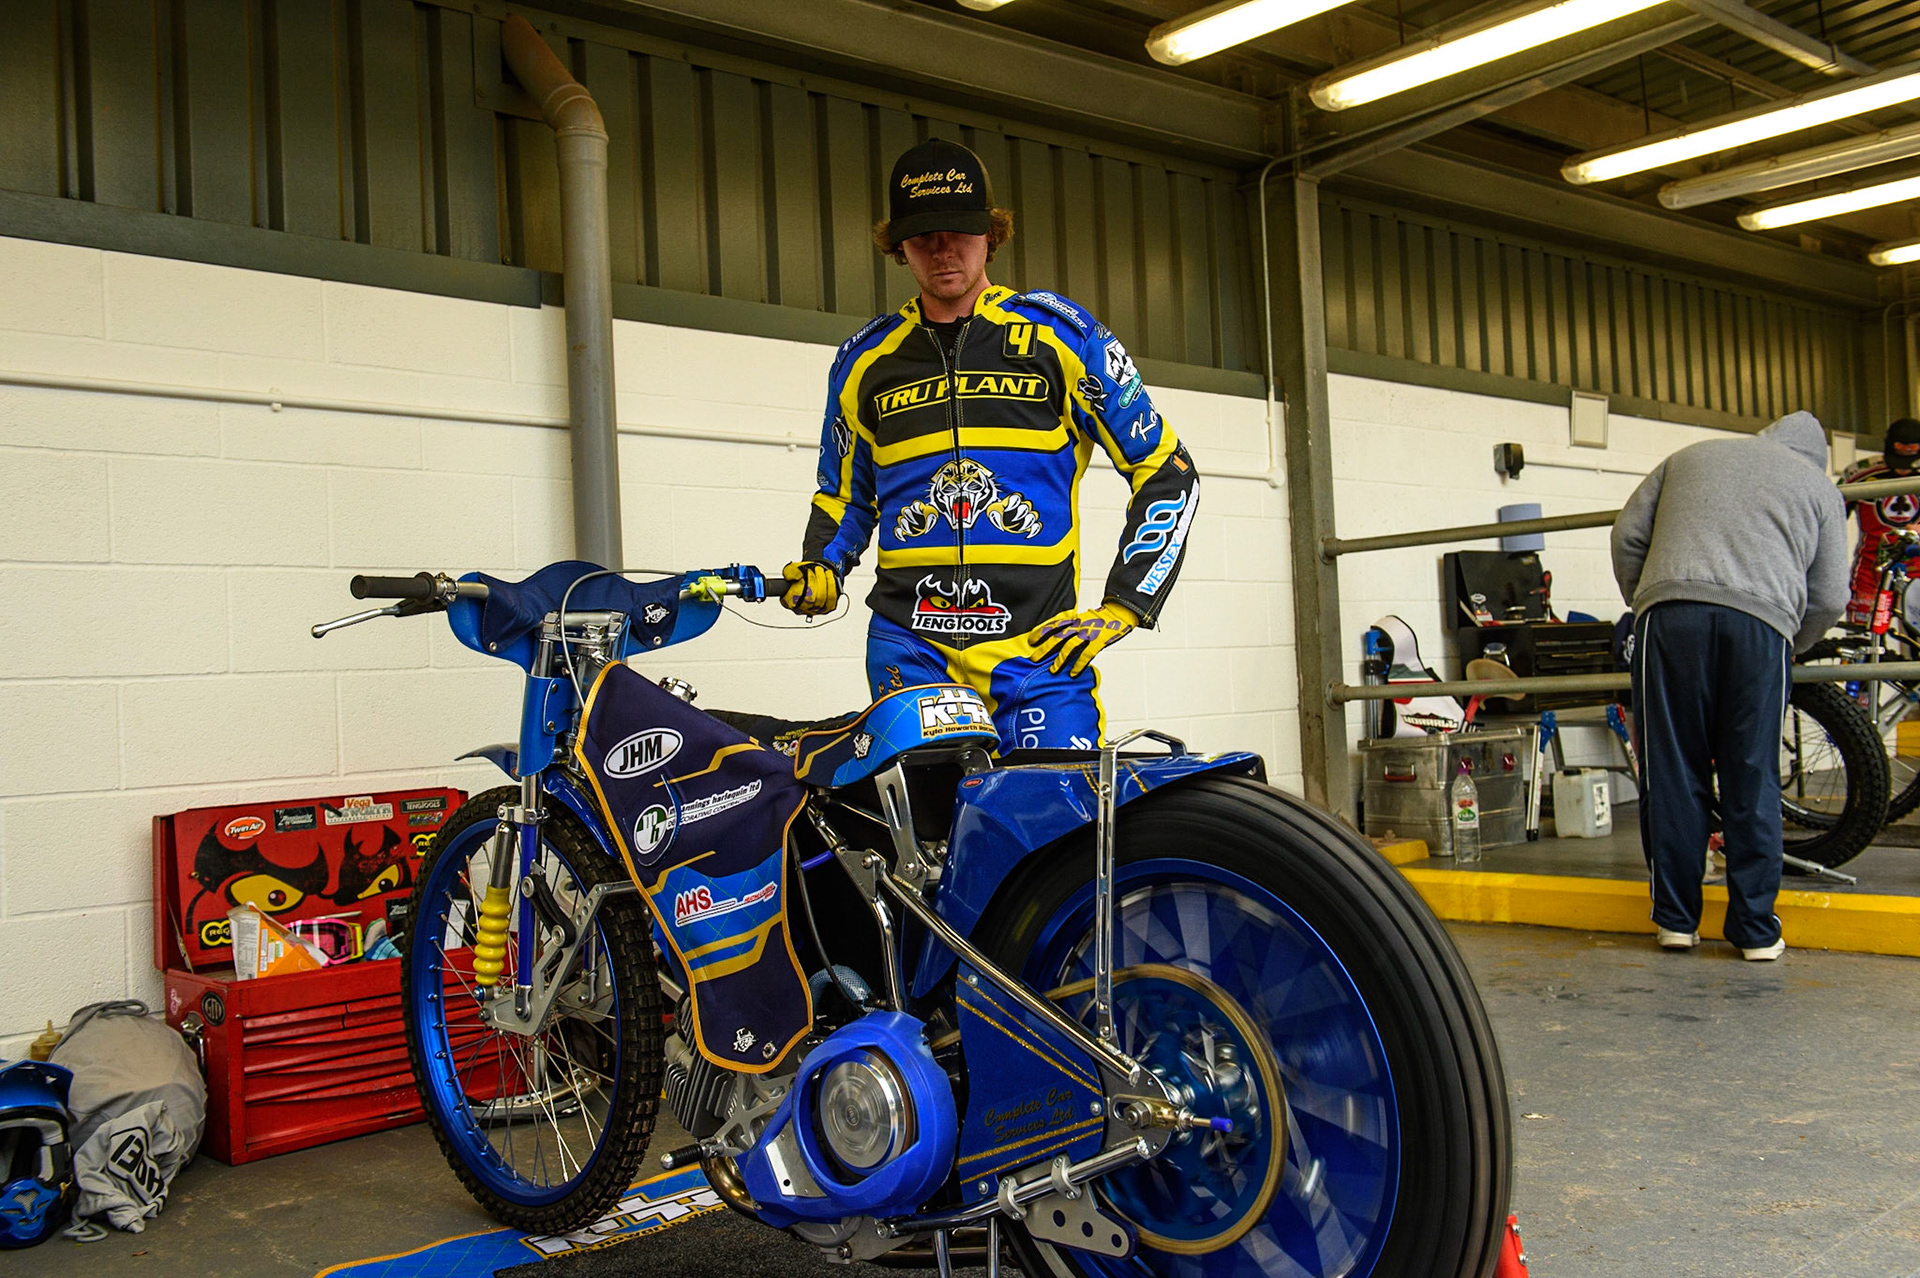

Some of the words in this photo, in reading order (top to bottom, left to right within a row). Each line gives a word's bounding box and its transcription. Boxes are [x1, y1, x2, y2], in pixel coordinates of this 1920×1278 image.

[900, 172, 944, 188] Complete
[946, 168, 967, 182] Car
[909, 184, 951, 198] Services
[954, 181, 974, 194] Ltd
[1008, 323, 1035, 356] 4
[880, 382, 932, 412] TRU
[1139, 536, 1181, 595] WESSEX
[923, 728, 944, 737] Kyle
[945, 724, 978, 733] Howarth
[619, 734, 664, 772] JHM
[749, 782, 760, 793] ltd
[346, 798, 371, 811] Vega
[229, 825, 249, 835] Twin
[249, 822, 262, 831] Air
[676, 888, 713, 918] AHS
[984, 1100, 1042, 1127] Complete
[1046, 1087, 1073, 1106] Car
[995, 1120, 1045, 1143] Services
[1048, 1106, 1074, 1126] Ltd
